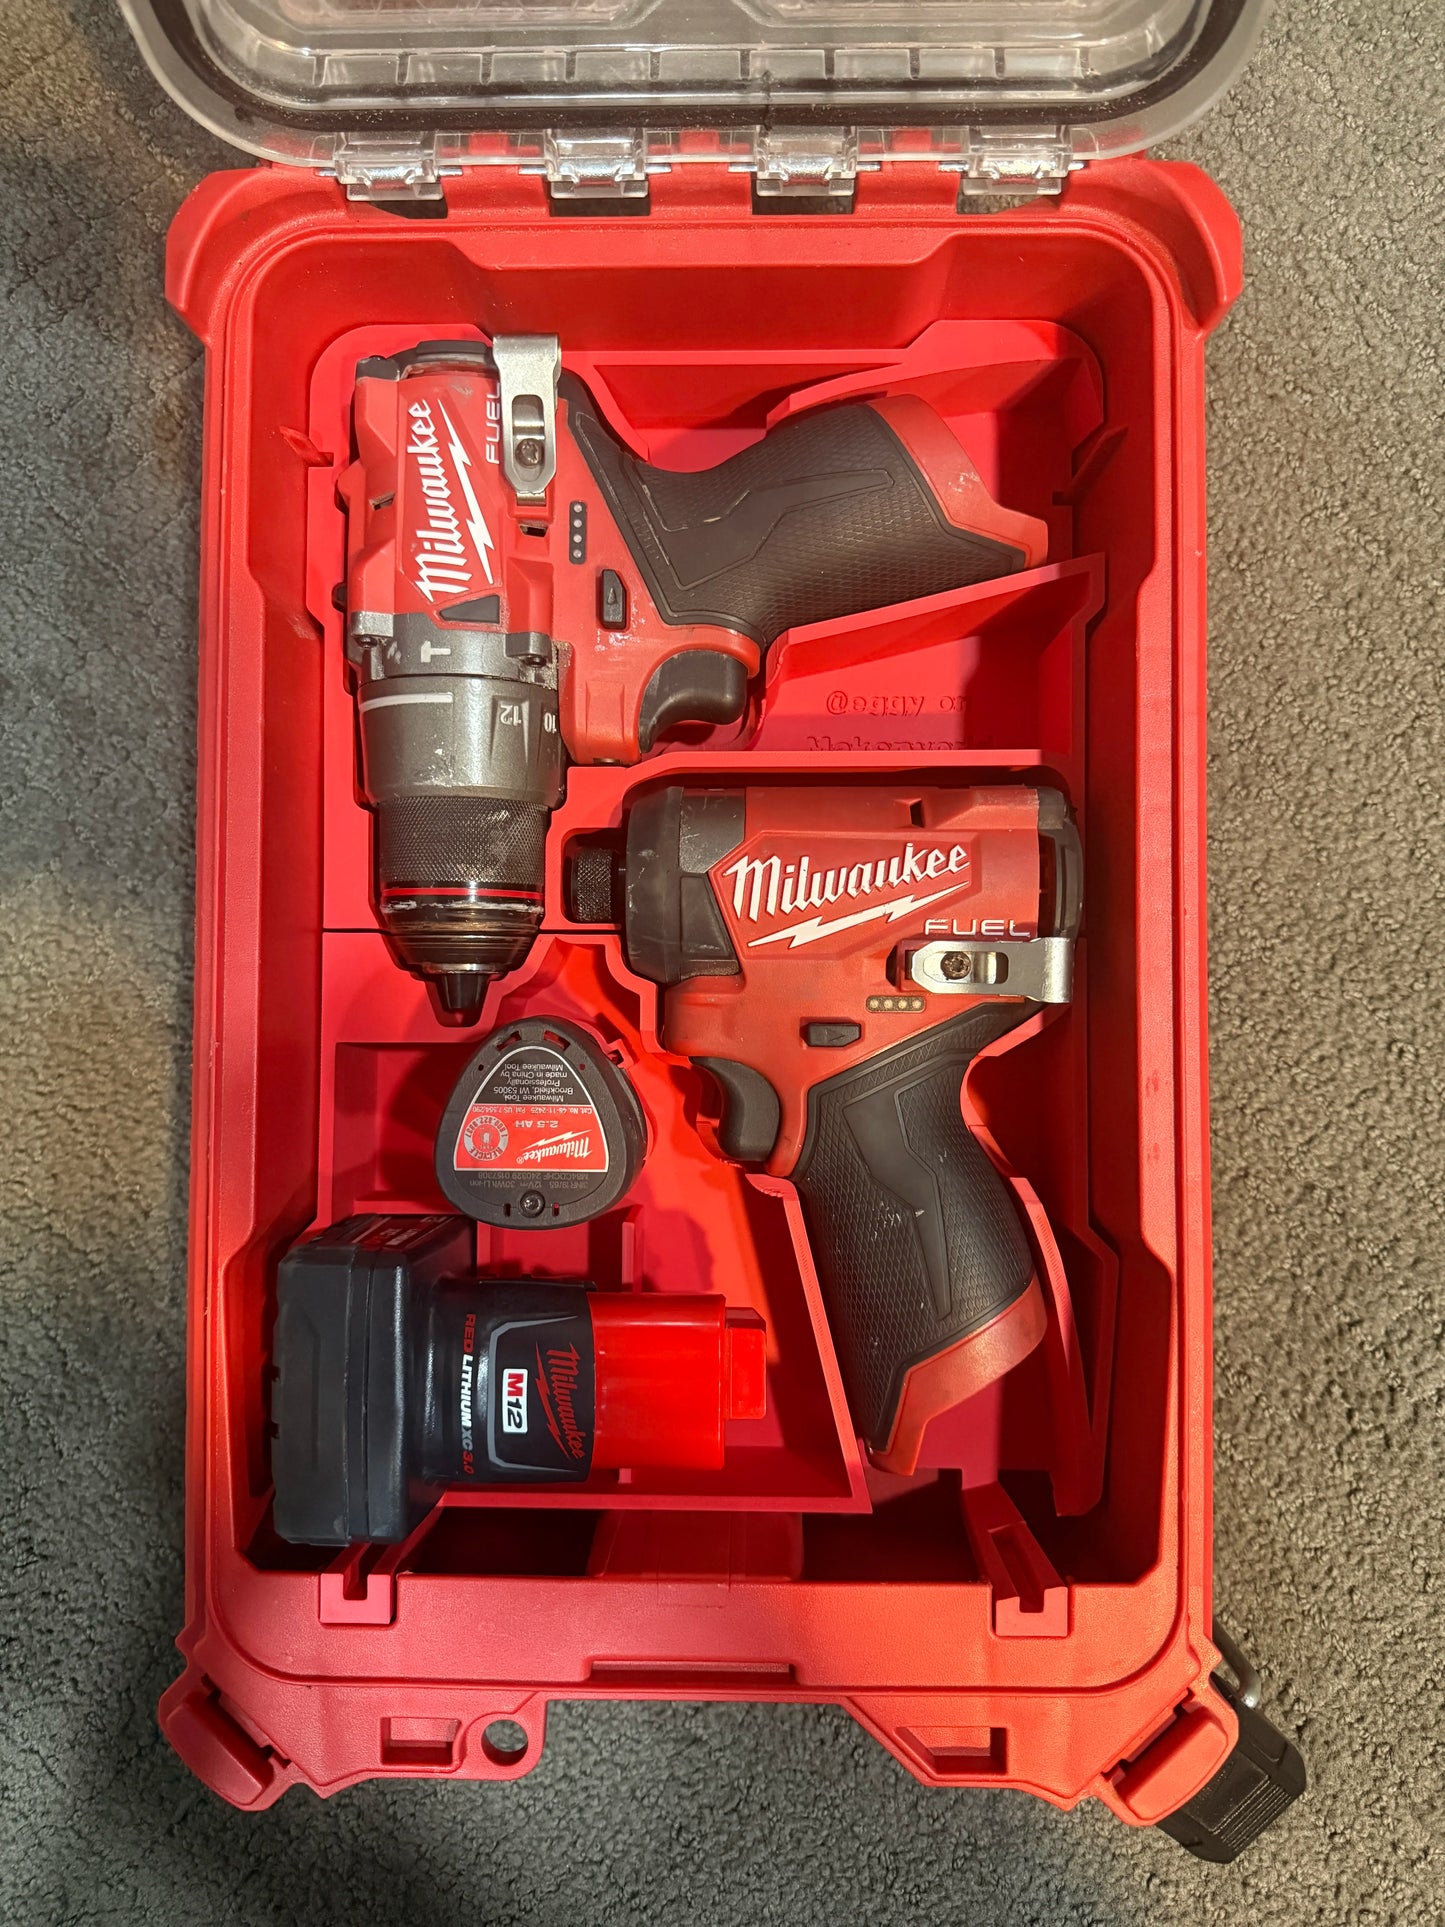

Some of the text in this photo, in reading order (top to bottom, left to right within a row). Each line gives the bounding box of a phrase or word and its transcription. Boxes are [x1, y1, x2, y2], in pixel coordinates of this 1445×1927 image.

[486, 382, 500, 464] FUEL
[407, 398, 473, 603] Milwaukee
[825, 690, 925, 717] @eggy
[500, 704, 522, 726] 12
[544, 712, 557, 733] 10
[723, 842, 970, 922] Milwaukee
[924, 918, 1030, 938] FUEL
[504, 1063, 564, 1072] Milwaukee Tool
[500, 1070, 568, 1079] made in China by
[506, 1079, 561, 1087] Professionally
[493, 1086, 518, 1094] 53005
[531, 1086, 574, 1095] Brookfield,
[522, 1095, 564, 1103] Milwaukee
[503, 1106, 513, 1114] US
[515, 1106, 526, 1114] Pat.
[568, 1107, 580, 1115] No.
[580, 1107, 593, 1115] Cat.
[514, 1119, 558, 1129] 2.5 AH
[469, 1146, 504, 1161] RECYCLE
[507, 1372, 524, 1429] M12
[546, 1341, 586, 1459] Milwaukee
[462, 1450, 475, 1475] 3.0
